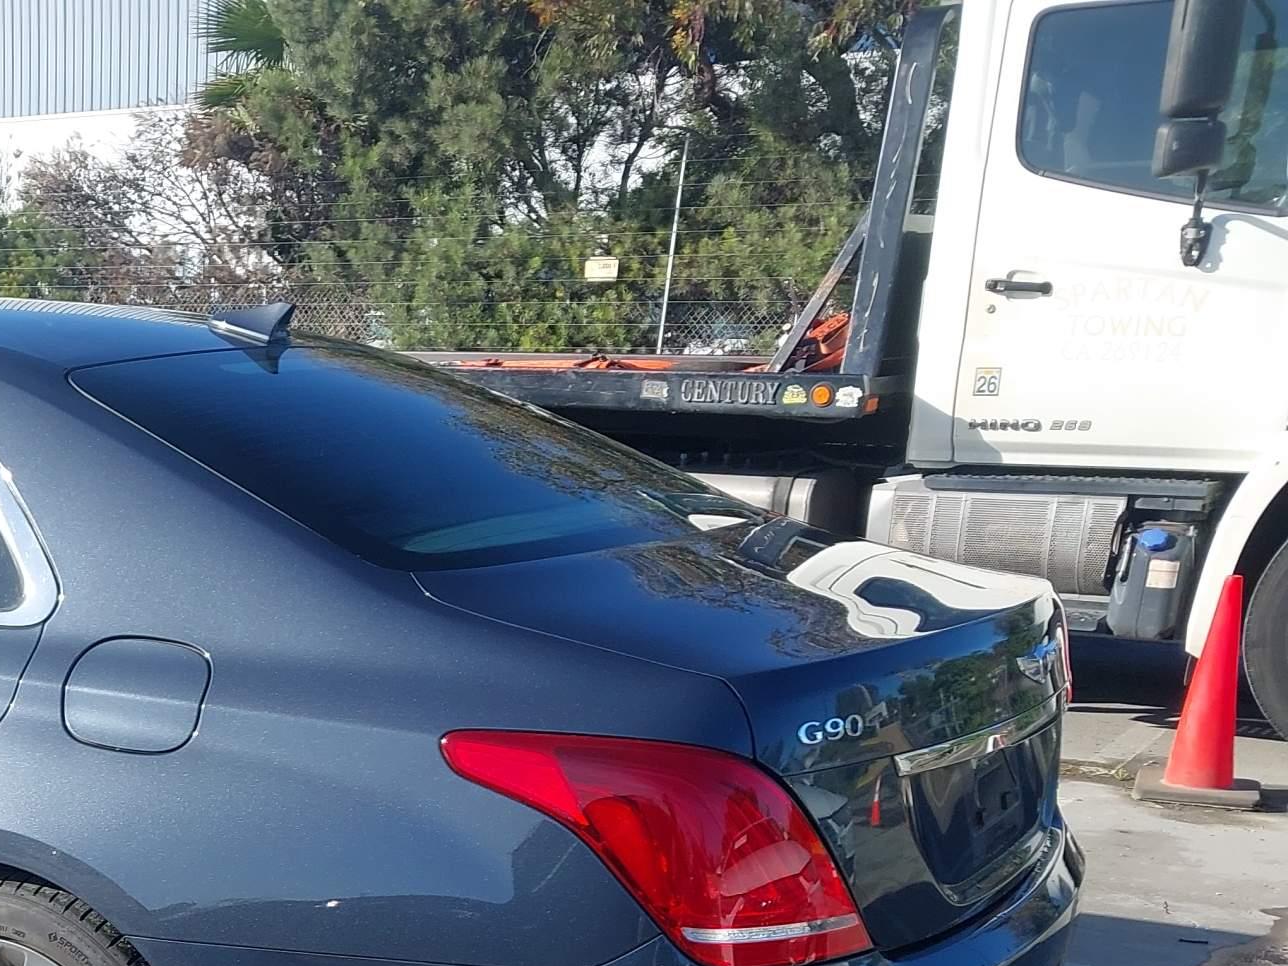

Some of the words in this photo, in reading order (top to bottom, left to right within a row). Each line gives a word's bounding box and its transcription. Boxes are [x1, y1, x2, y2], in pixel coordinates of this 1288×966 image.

[1057, 278, 1212, 313] SPARTAN
[1068, 314, 1188, 338] TOWING
[680, 378, 780, 406] CENTURY
[975, 375, 998, 394] 26
[967, 418, 1042, 432] HINO
[797, 714, 863, 745] G90
